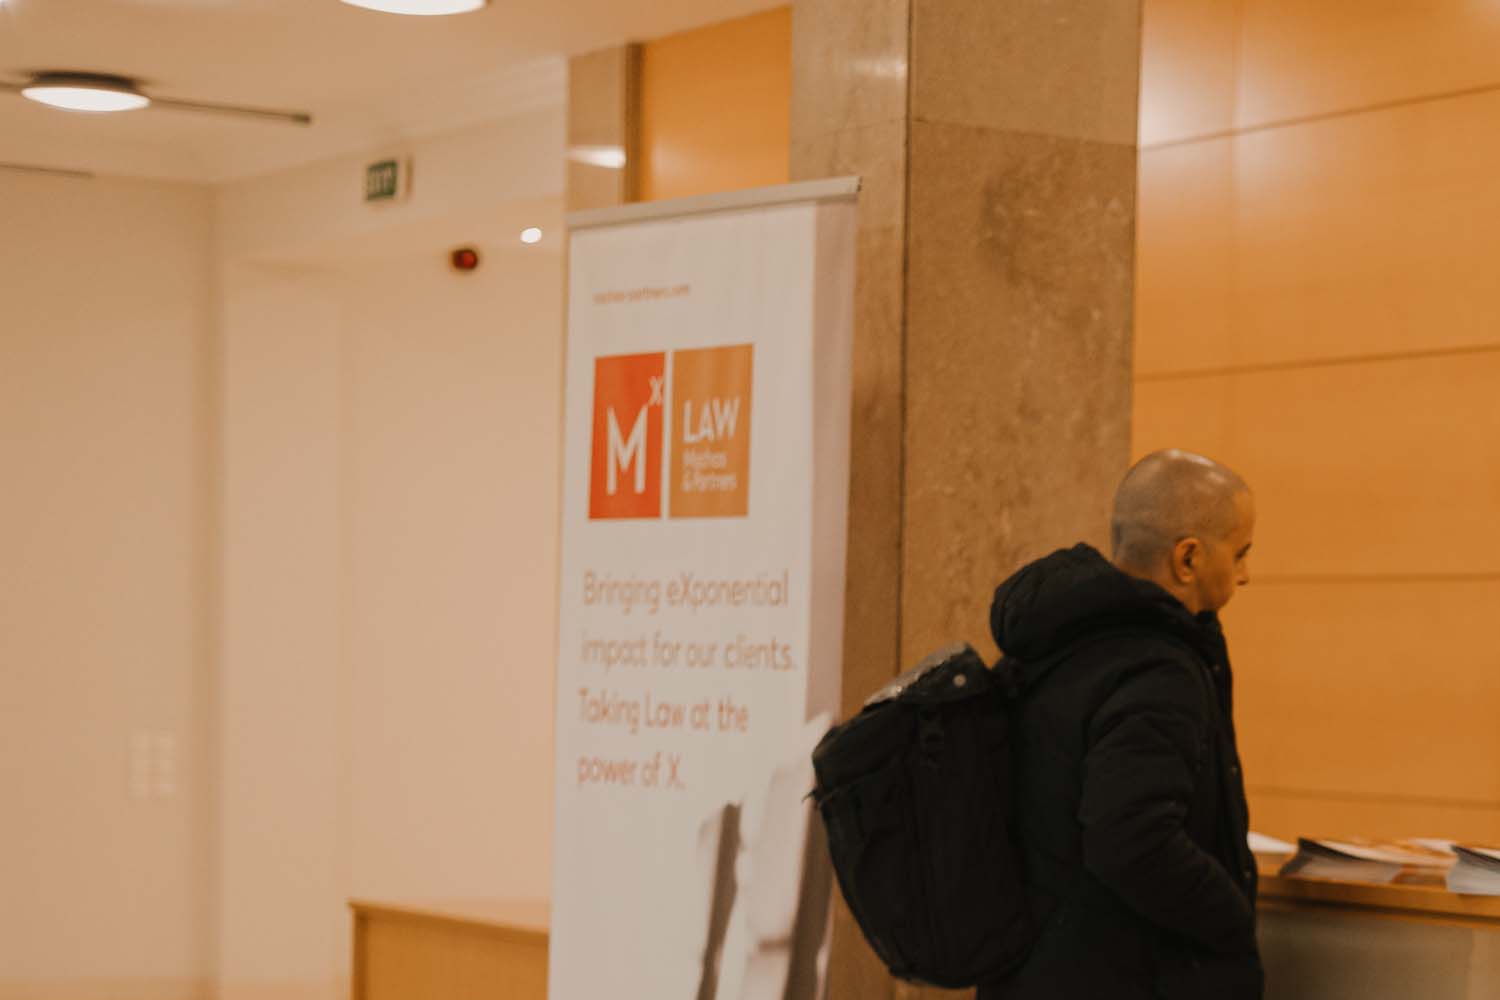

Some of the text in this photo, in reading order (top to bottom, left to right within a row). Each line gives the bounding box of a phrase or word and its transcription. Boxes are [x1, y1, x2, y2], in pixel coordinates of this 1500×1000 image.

[683, 396, 739, 444] LAW
[584, 568, 789, 615] Bringing eXponential
[580, 630, 647, 673] impact
[652, 625, 681, 666] for
[686, 643, 717, 668] our
[578, 688, 748, 735] Taking Law at the
[577, 757, 637, 787] power
[641, 752, 661, 786] of
